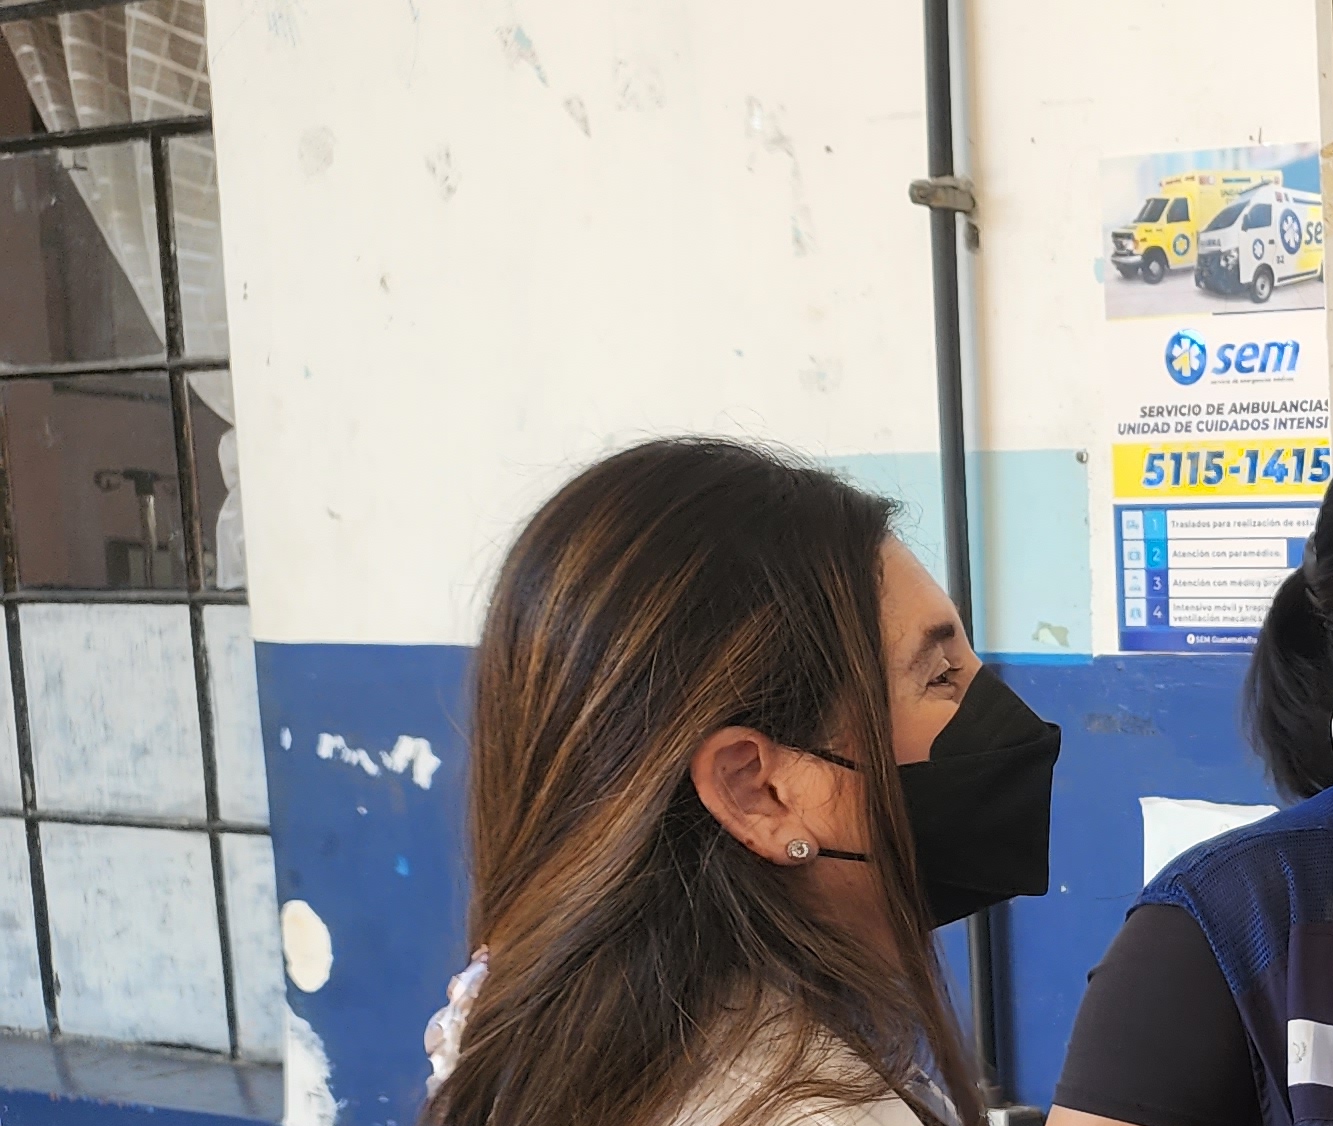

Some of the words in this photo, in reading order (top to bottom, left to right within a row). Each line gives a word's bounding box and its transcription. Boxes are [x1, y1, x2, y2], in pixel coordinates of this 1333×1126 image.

[1212, 338, 1300, 375] sem
[1140, 403, 1201, 418] SERVICIO
[1206, 403, 1225, 415] DE
[1117, 422, 1171, 435] UNIDAD
[1174, 421, 1192, 433] DE
[1196, 418, 1270, 432] CUIDADOS
[1142, 447, 1331, 488] 5115-1415
[1171, 519, 1210, 529] Traslados
[1212, 520, 1231, 530] para
[1233, 518, 1281, 528] realización
[1283, 519, 1293, 527] de
[1152, 547, 1161, 561] 2
[1172, 548, 1210, 558] Atención
[1153, 576, 1162, 590] 3
[1173, 578, 1211, 588] Atención
[1153, 605, 1162, 619] 4
